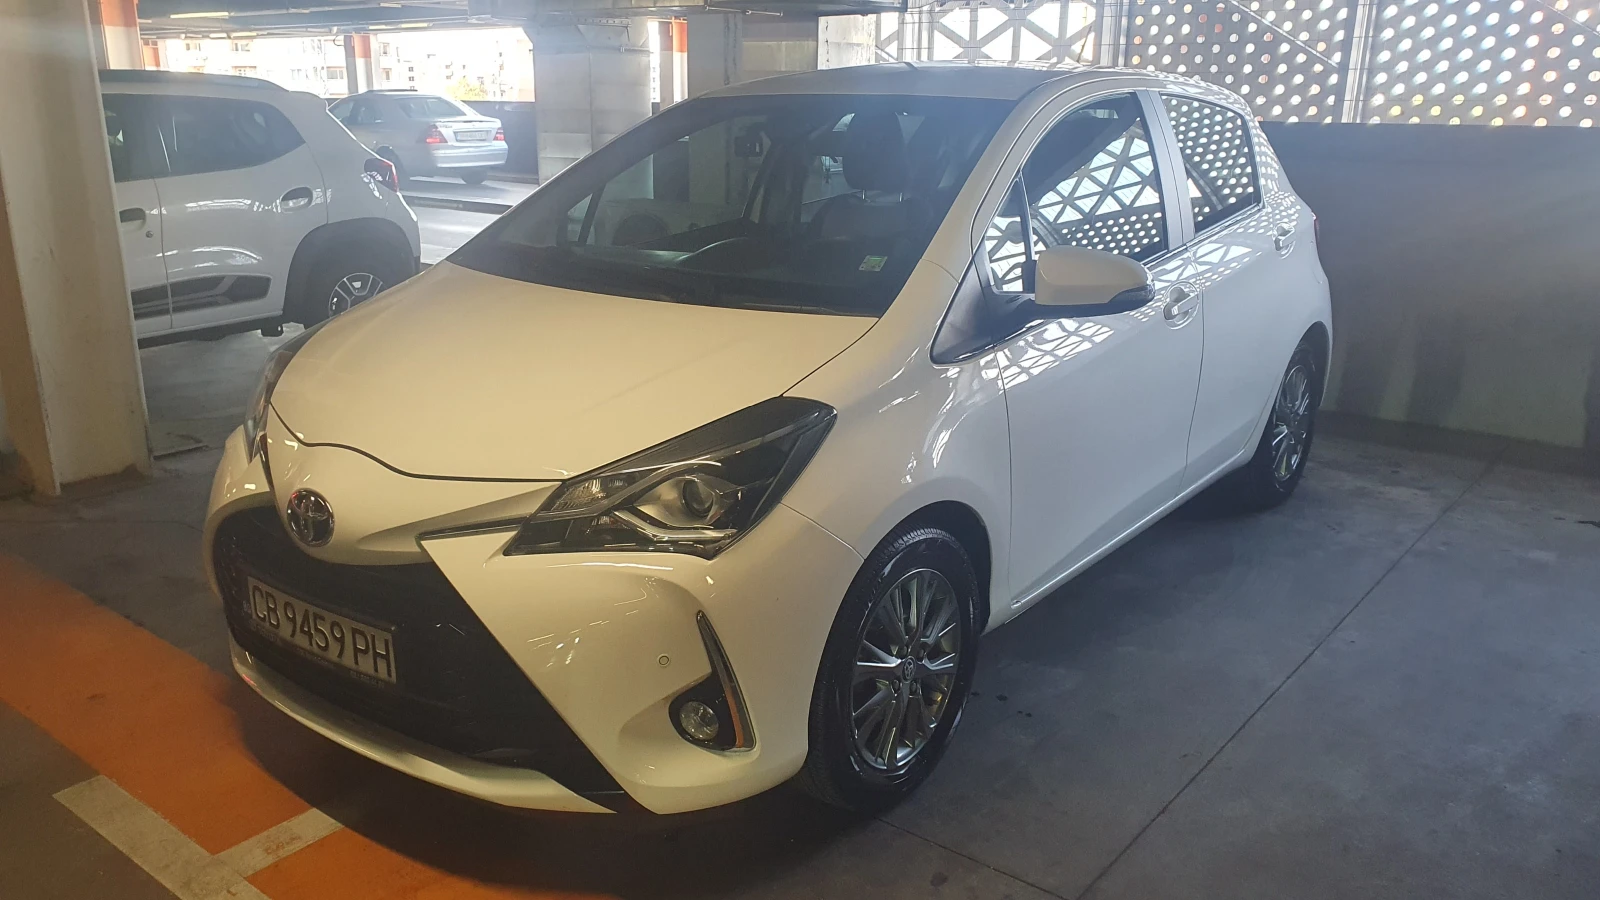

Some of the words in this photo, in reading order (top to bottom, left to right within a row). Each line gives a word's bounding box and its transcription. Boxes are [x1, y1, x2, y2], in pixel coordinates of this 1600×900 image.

[252, 585, 281, 630] CB
[283, 601, 346, 659] 9459
[352, 627, 392, 678] PH
